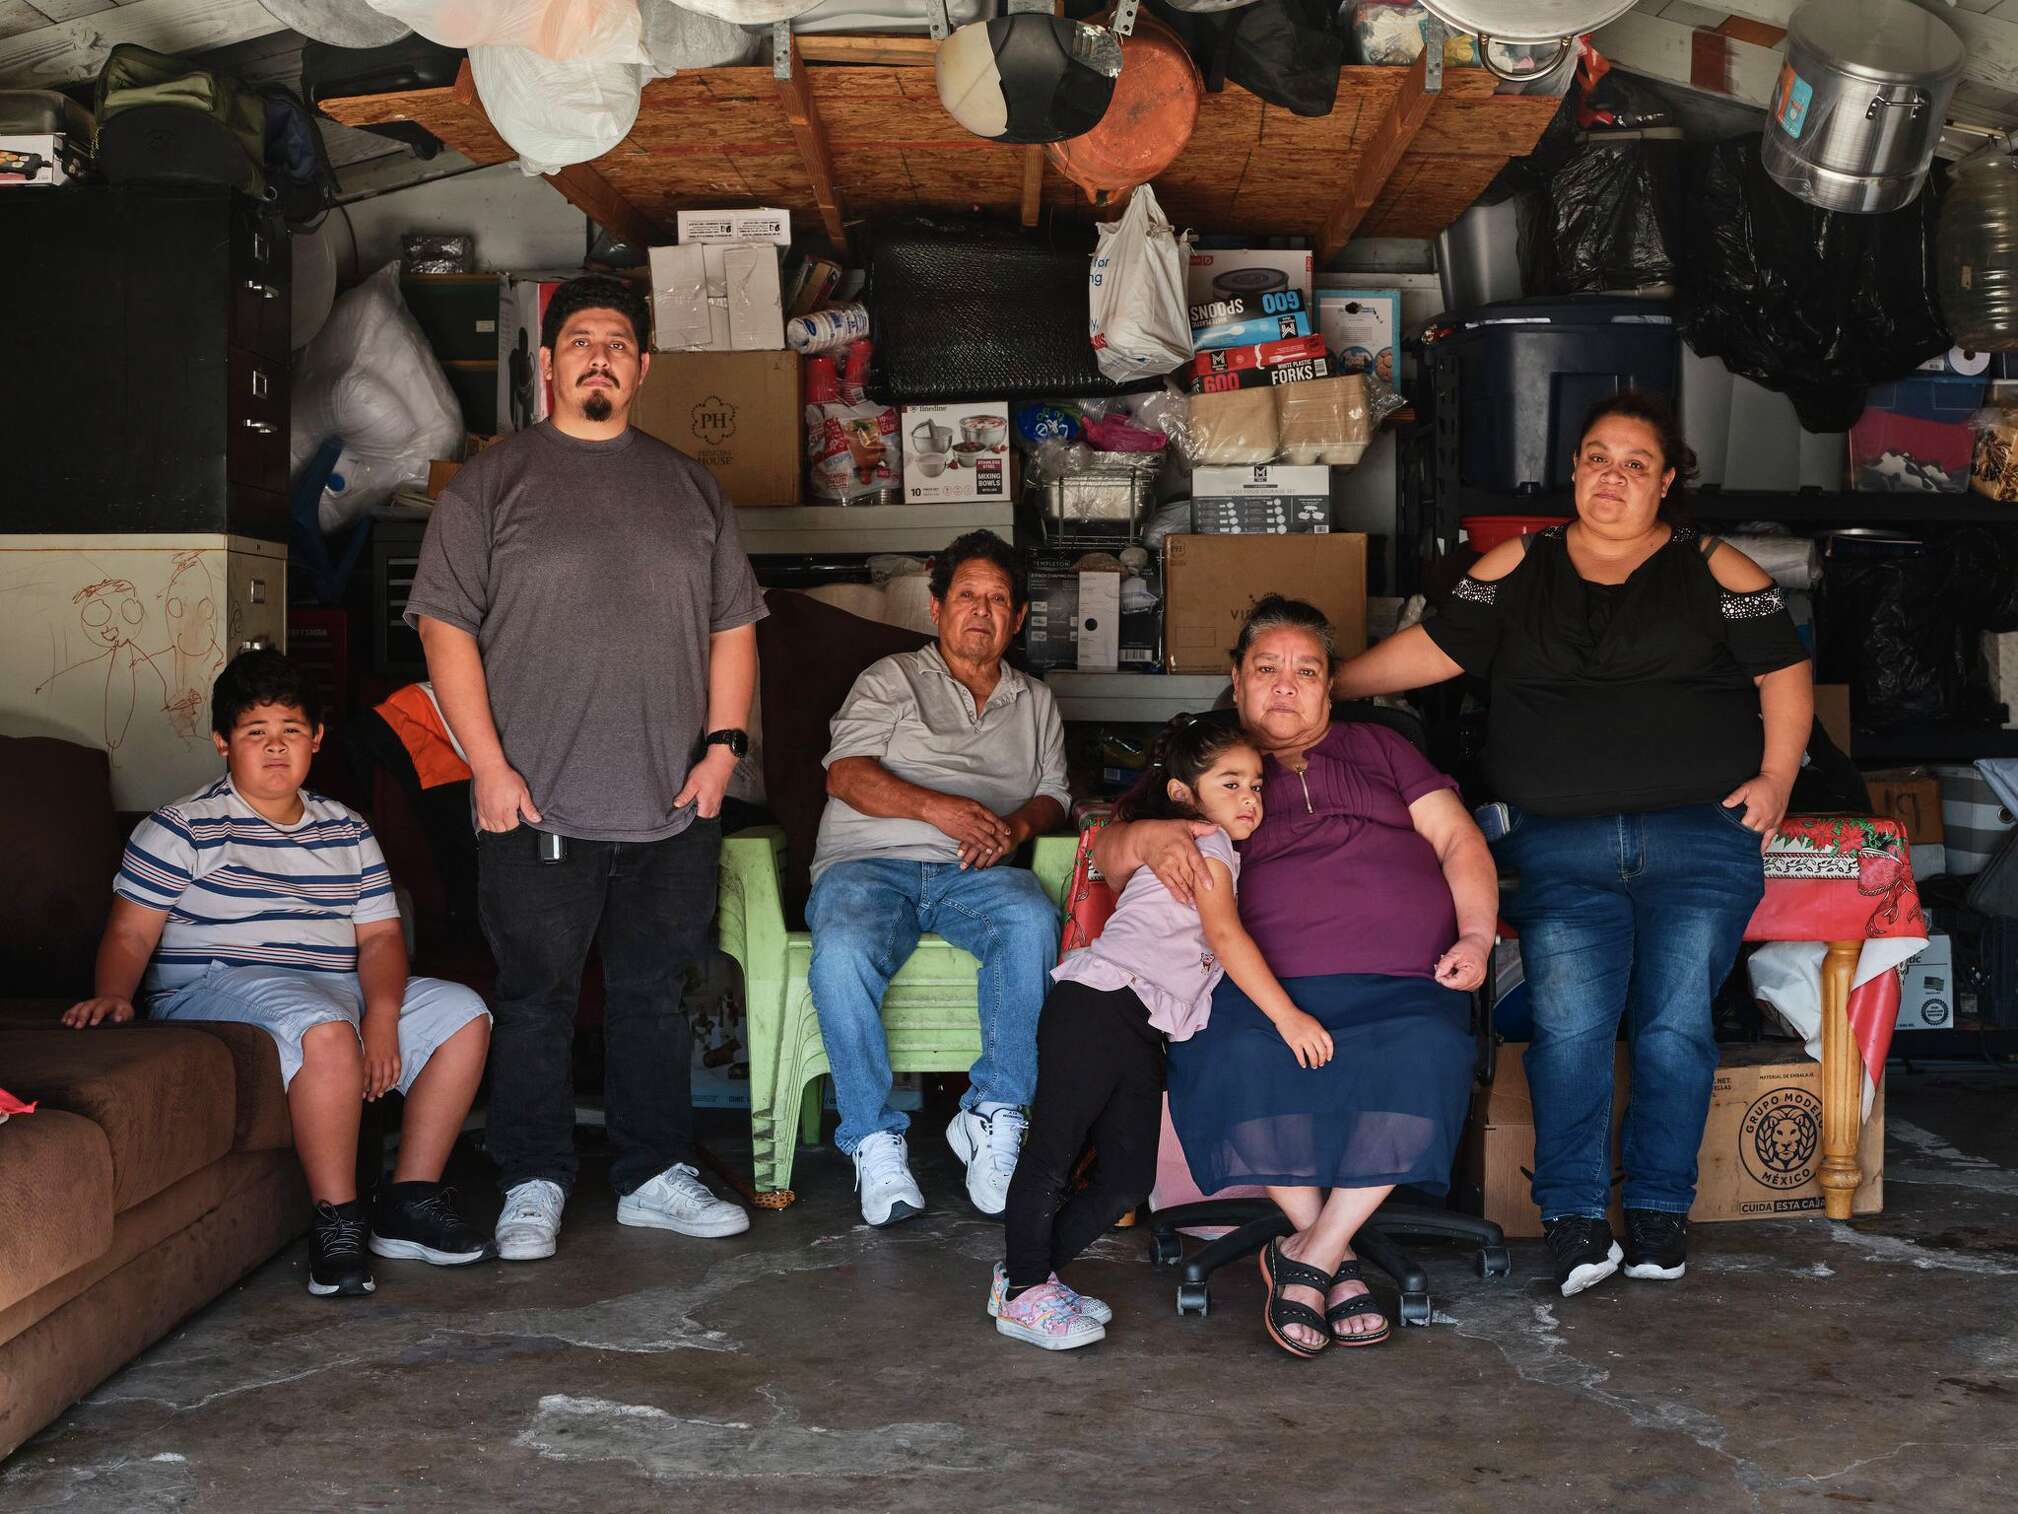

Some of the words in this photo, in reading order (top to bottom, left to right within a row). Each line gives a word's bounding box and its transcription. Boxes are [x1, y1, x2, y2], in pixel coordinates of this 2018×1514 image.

[1190, 299, 1245, 322] SPOONS
[1262, 291, 1301, 315] 600
[1203, 372, 1240, 394] 600
[1271, 366, 1314, 386] FORKS
[701, 413, 728, 429] PH
[910, 487, 922, 497] 10
[1745, 1095, 1780, 1134] GRUPO
[1761, 1167, 1811, 1186] MÉXICO
[1741, 1201, 1773, 1213] CUIDA
[1775, 1200, 1800, 1210] ESTA
